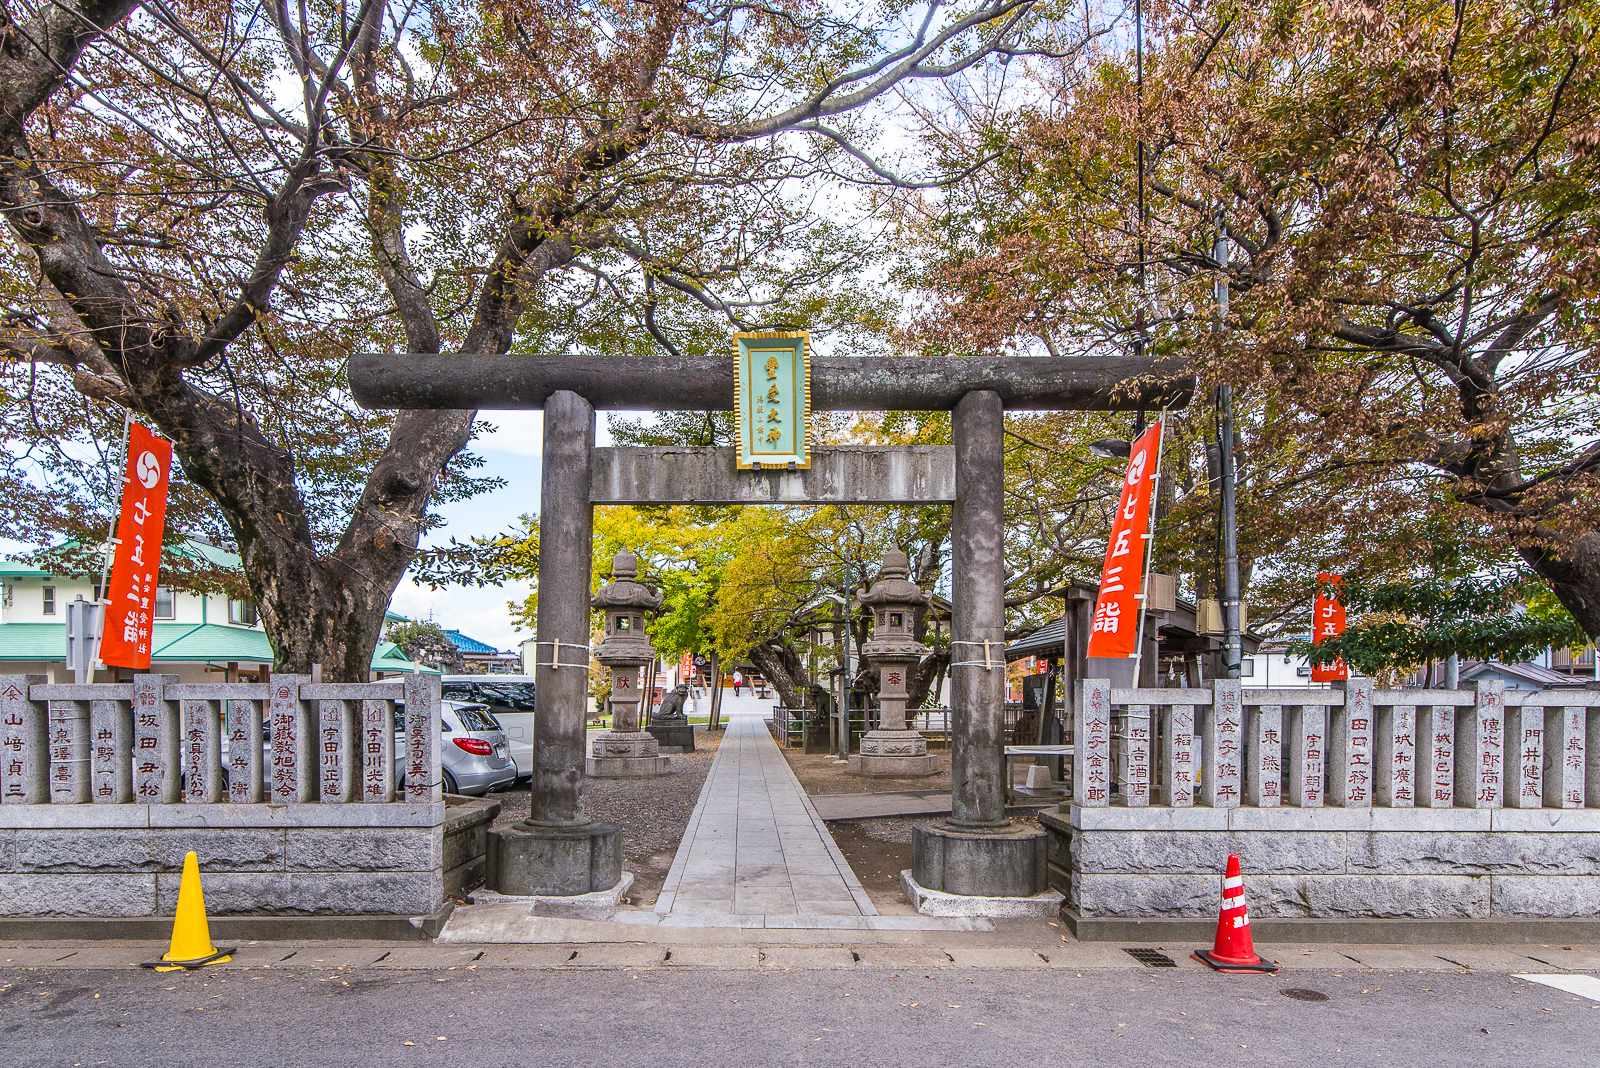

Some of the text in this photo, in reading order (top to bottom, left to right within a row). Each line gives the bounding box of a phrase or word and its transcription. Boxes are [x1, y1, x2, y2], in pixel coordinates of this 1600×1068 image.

[1093, 493, 1138, 634] 七五三詣
[1348, 719, 1370, 801] 田口工務店
